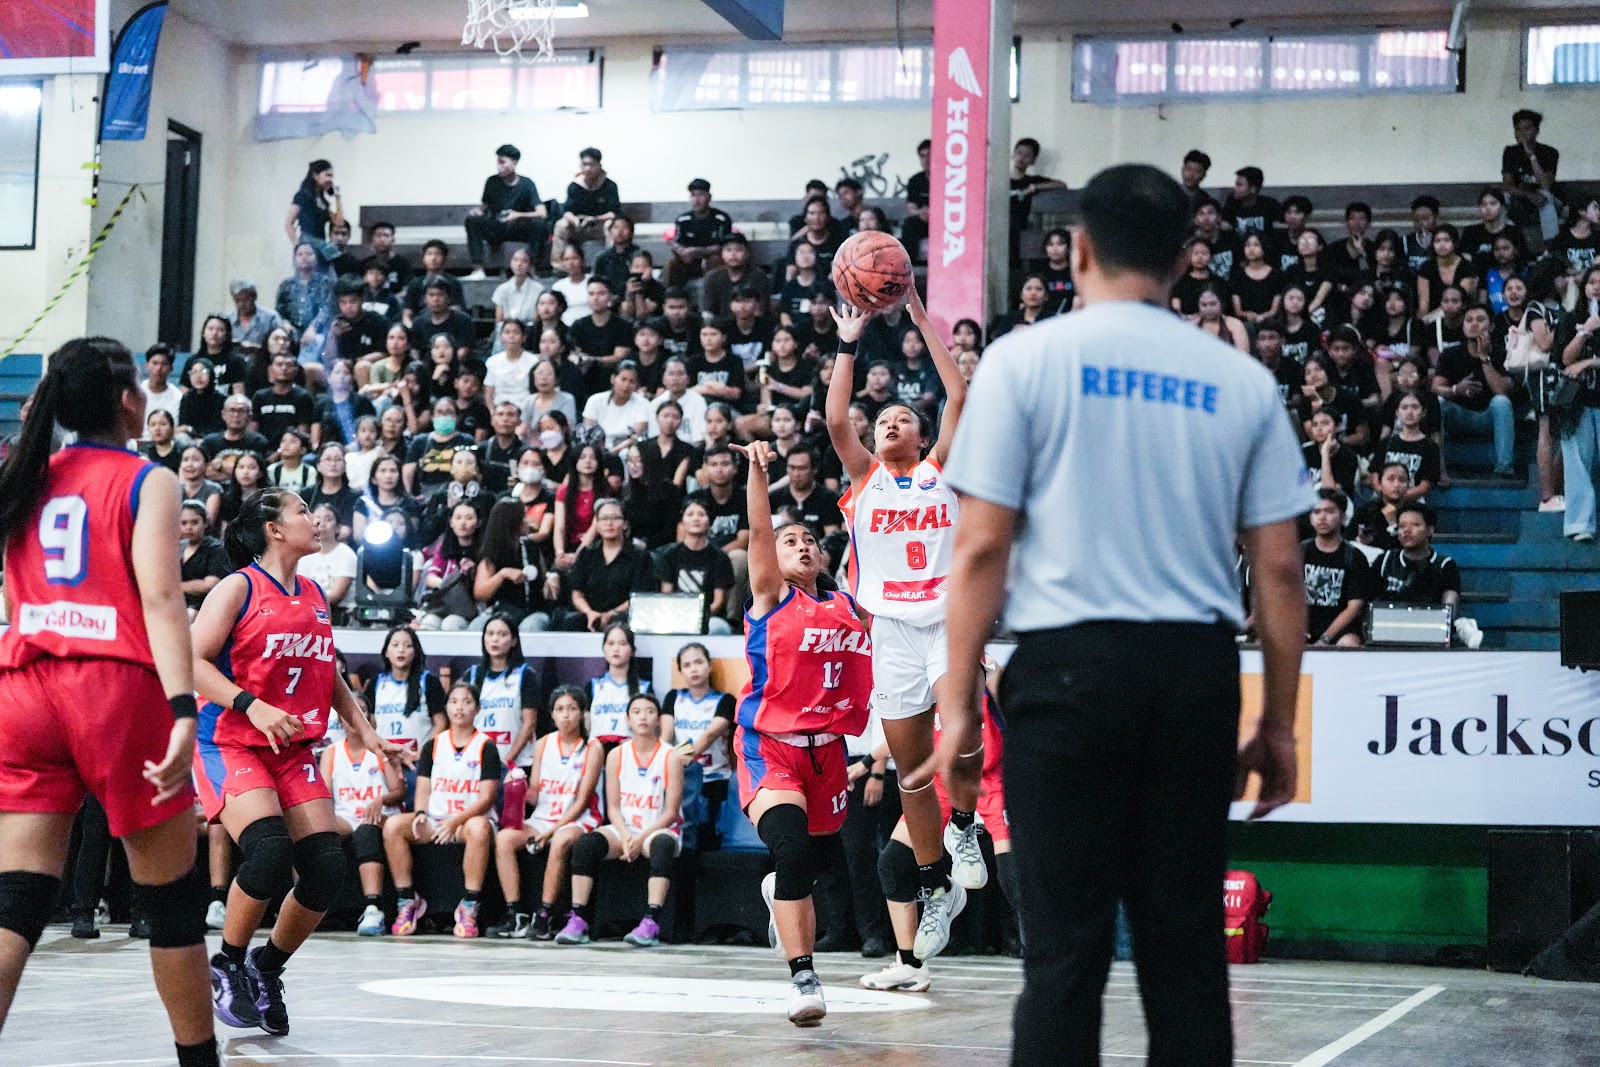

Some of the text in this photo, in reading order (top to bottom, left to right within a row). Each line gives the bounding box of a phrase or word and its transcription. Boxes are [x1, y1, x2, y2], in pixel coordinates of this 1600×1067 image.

[943, 97, 970, 268] HONDA
[1081, 364, 1218, 415] REFEREE
[870, 504, 952, 534] FINAL
[39, 494, 90, 587] 9
[906, 541, 928, 570] 8
[69, 611, 106, 634] Day
[262, 631, 334, 662] FINAL
[798, 627, 872, 656] FINAL
[285, 667, 302, 695] 7
[823, 661, 843, 690] 12
[390, 721, 403, 735] 12
[482, 712, 496, 728] 16
[610, 719, 619, 731] 7
[303, 763, 317, 783] 7
[434, 778, 481, 793] FINAL
[831, 789, 847, 815] 12
